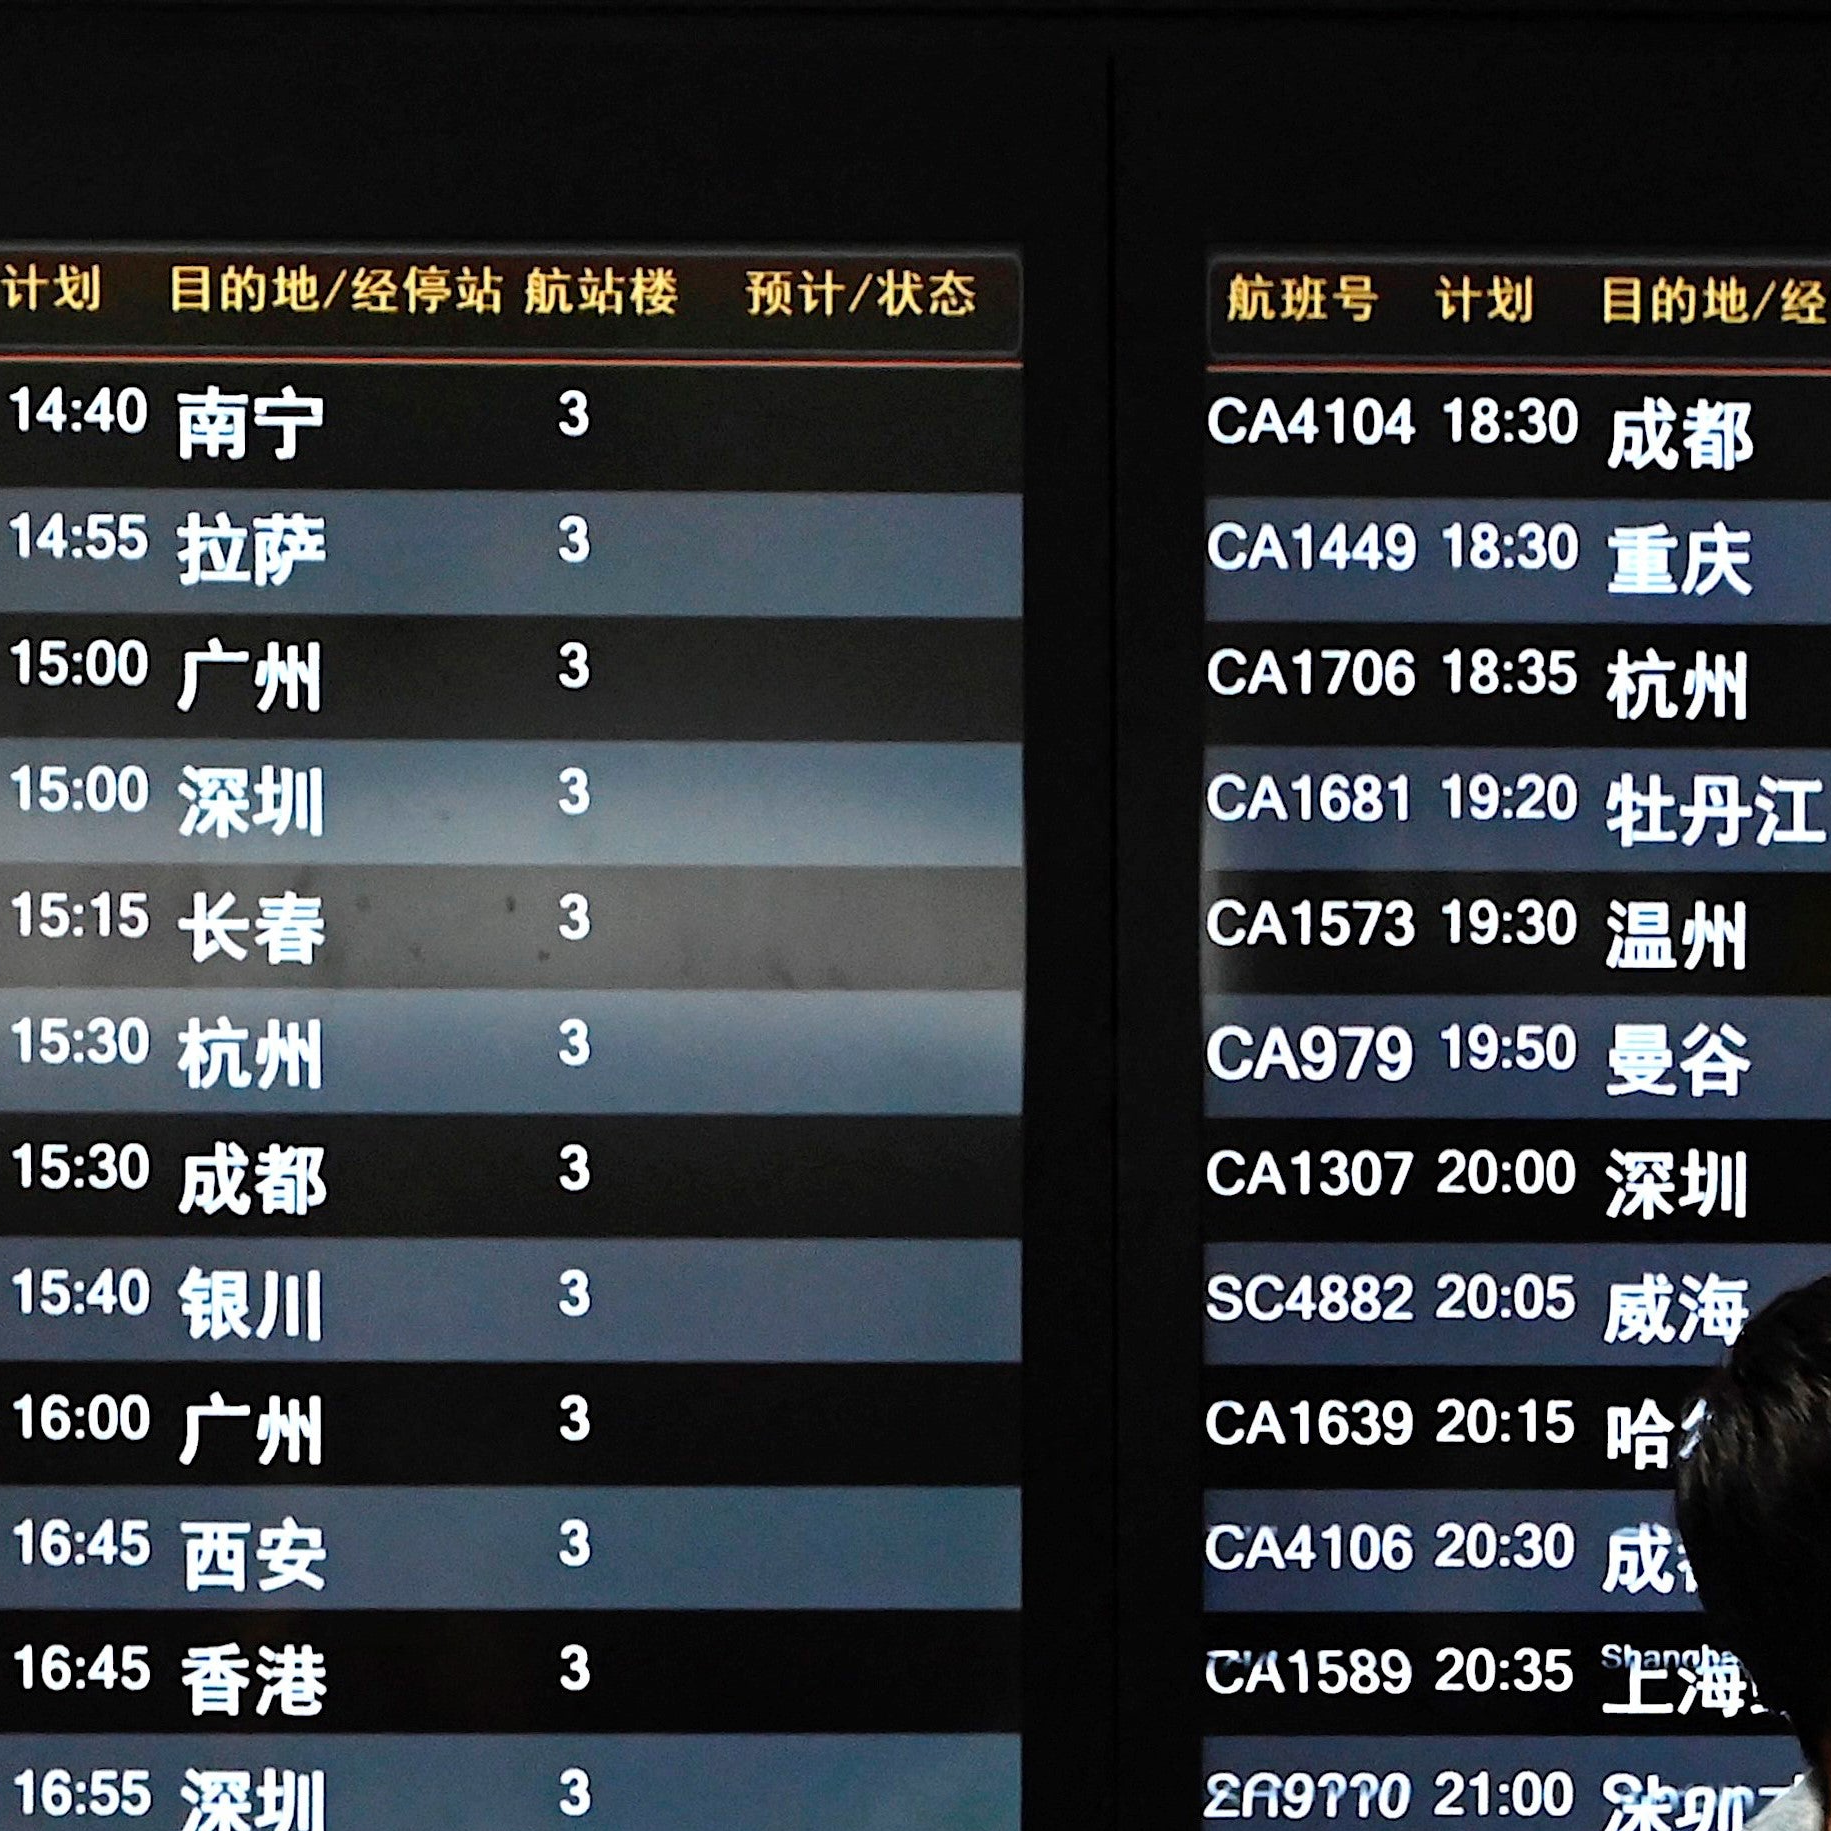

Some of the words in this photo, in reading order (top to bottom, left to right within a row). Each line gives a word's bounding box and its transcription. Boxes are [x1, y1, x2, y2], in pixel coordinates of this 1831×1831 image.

[1, 262, 101, 312] 计划
[171, 263, 504, 314] 目的地/经停站
[524, 265, 679, 316] 航站楼
[745, 268, 976, 317] 预计/状态
[1227, 273, 1379, 322] 航班号
[1435, 275, 1534, 323] 计划
[8, 385, 149, 434] 14:40
[176, 384, 325, 461] 南宁
[557, 388, 590, 437] 3
[1207, 395, 1417, 446] CA4104
[1442, 396, 1580, 445] 18:30
[1606, 395, 1755, 472] 成都
[8, 511, 149, 561] 14:55
[175, 510, 327, 588] 拉萨
[557, 514, 591, 564] 3
[1206, 521, 1417, 572] CA1449
[1441, 521, 1580, 571] 18:30
[1606, 519, 1754, 597] 重庆
[1206, 647, 1417, 697] CA1706
[1442, 647, 1579, 696] 18:35
[1605, 646, 1748, 721] 杭州
[1206, 772, 1409, 823] CA1681
[1440, 772, 1579, 822] 19:20
[1605, 771, 1828, 849] 牡丹江
[10, 889, 150, 940] 15:15
[176, 889, 326, 966] 长春
[557, 891, 591, 942] 3
[1206, 898, 1416, 948] CA1573
[1440, 897, 1578, 946] 19:30
[1604, 898, 1747, 971] 温州
[1206, 1024, 1414, 1083] CA979
[1440, 1022, 1578, 1071] 19:50
[1605, 1021, 1752, 1098] 曼谷
[11, 1141, 151, 1191] 15:30
[177, 1140, 328, 1217] 成都
[558, 1143, 591, 1192] 3
[1205, 1148, 1415, 1197] CA1307
[1436, 1148, 1577, 1196] 20:00
[1604, 1147, 1748, 1221] 深圳
[11, 1266, 151, 1317] 15:40
[176, 1264, 322, 1343] 银川
[558, 1267, 591, 1318] 3
[12, 1517, 151, 1567] 16:45
[179, 1515, 328, 1593] 西安
[558, 1518, 592, 1568] 3
[13, 1643, 152, 1692] 16:45
[180, 1641, 328, 1717] 香港
[559, 1643, 592, 1692] 3
[13, 1768, 152, 1817] 16:55
[558, 1767, 592, 1817] 3
